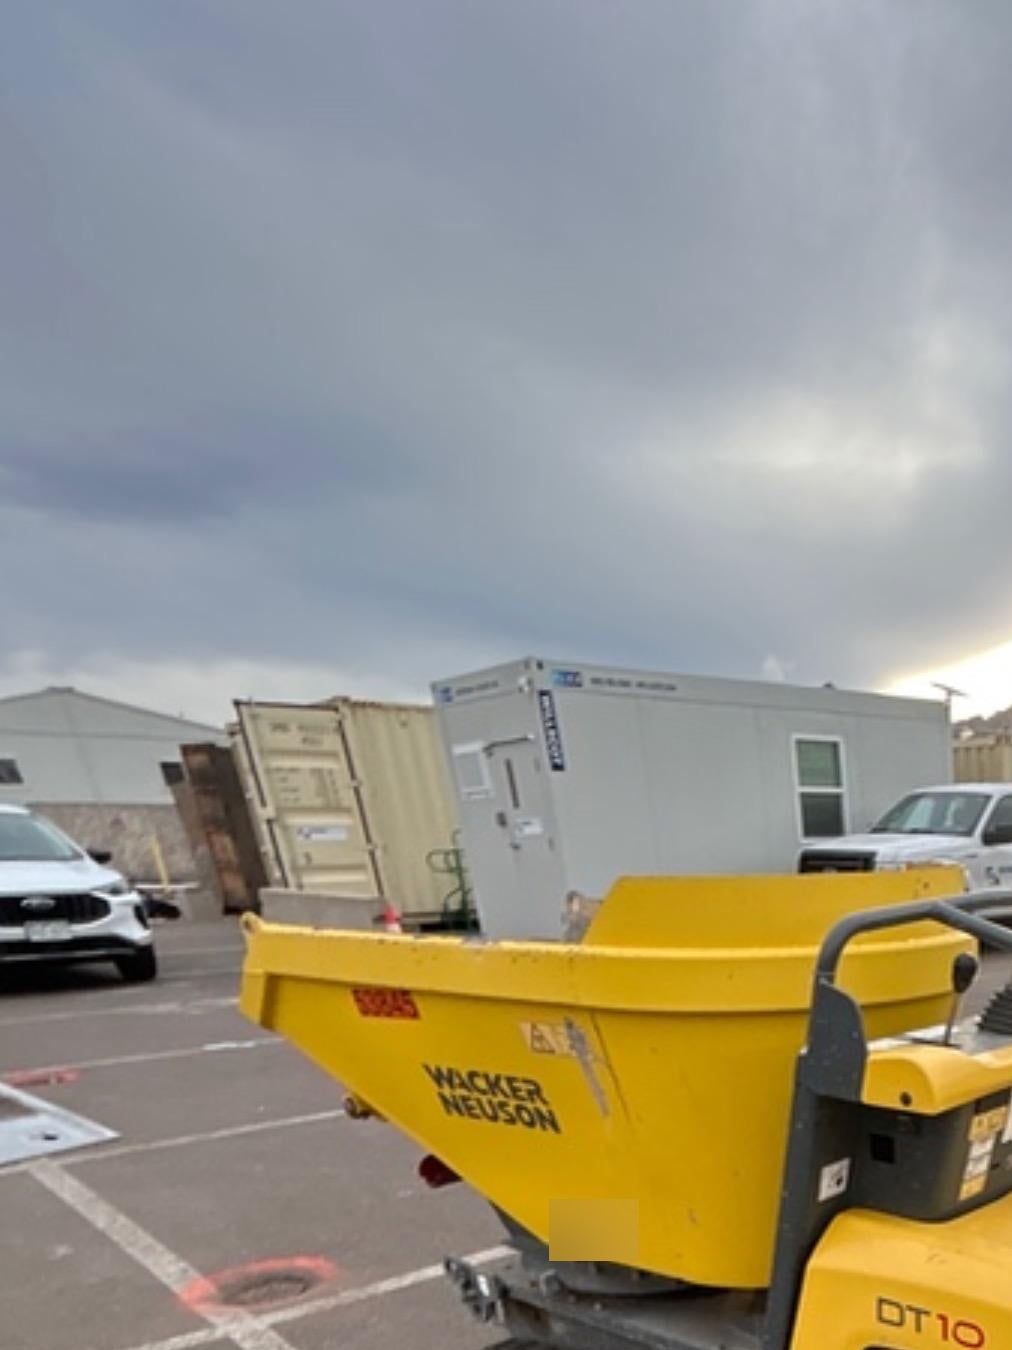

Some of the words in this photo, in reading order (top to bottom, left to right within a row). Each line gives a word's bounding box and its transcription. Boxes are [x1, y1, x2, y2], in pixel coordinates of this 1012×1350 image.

[422, 1062, 549, 1105] WACKER
[437, 1091, 562, 1134] NEUSON
[877, 1296, 985, 1349] DT10
